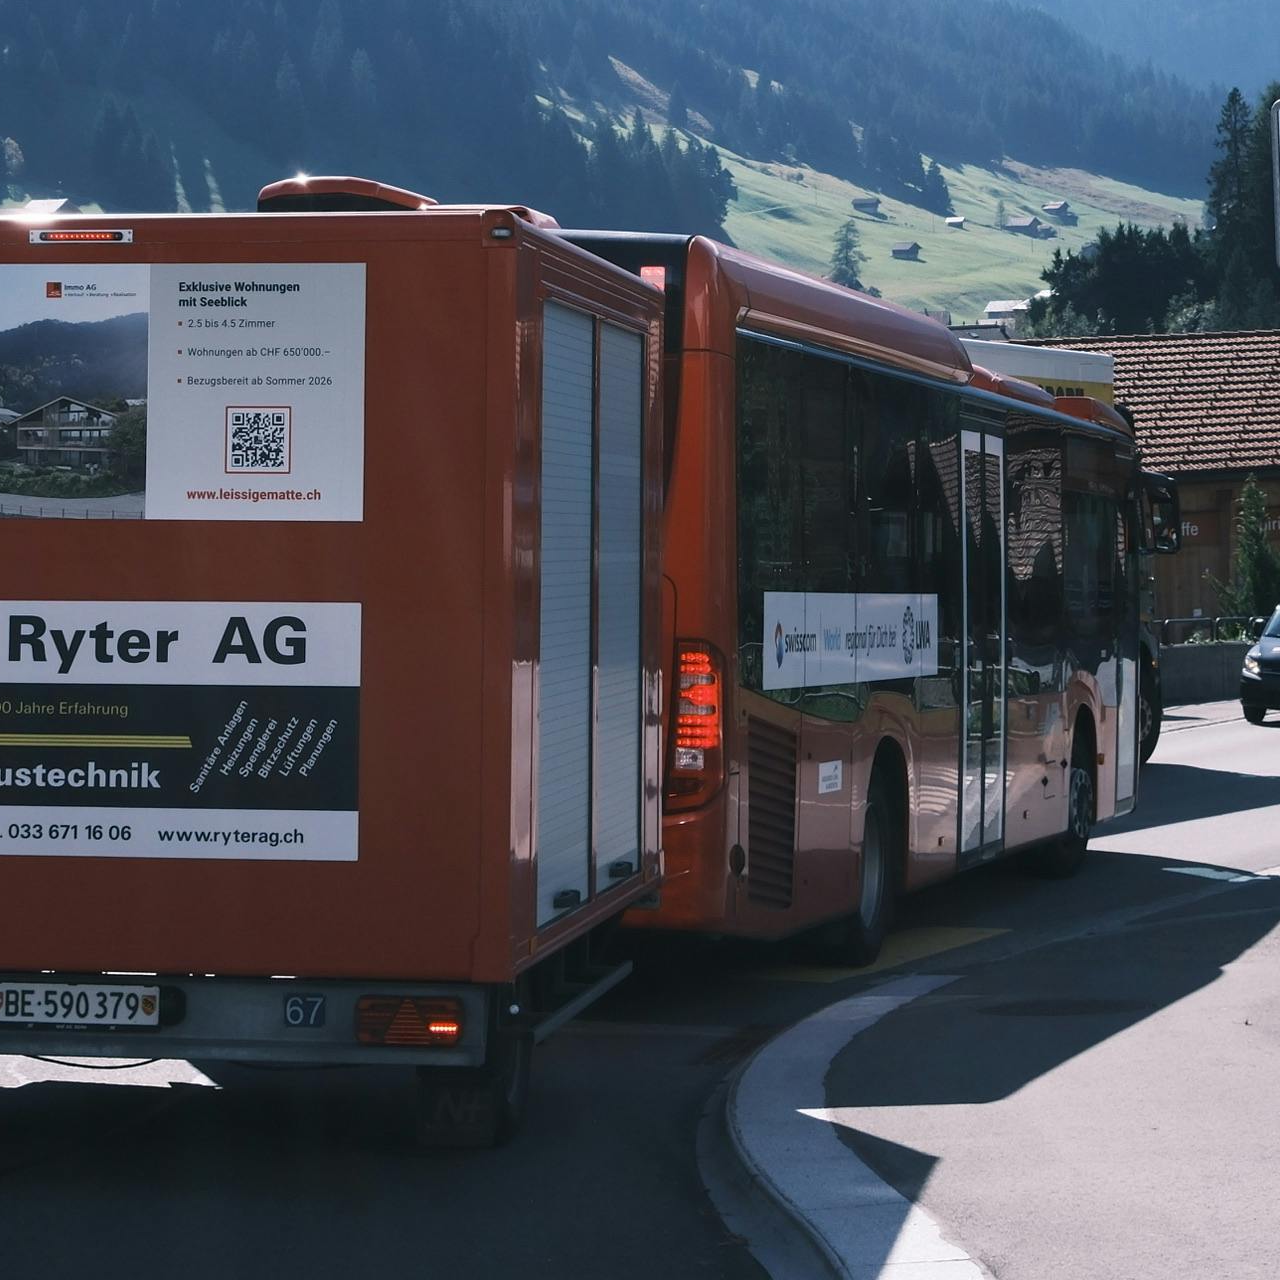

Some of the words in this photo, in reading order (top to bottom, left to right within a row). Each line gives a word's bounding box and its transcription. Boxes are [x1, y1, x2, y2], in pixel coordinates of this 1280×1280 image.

[178, 281, 232, 292] Exklusive
[234, 282, 299, 294] Wohnungen
[178, 296, 197, 307] mit
[199, 296, 248, 308] Seeblick
[187, 318, 203, 328] 2.5
[204, 318, 220, 329] bis
[221, 318, 237, 328] 4.5
[238, 318, 276, 328] Zimmer
[187, 347, 244, 359] Wohnungen
[245, 347, 258, 357] ab
[259, 347, 281, 357] CHF
[187, 375, 249, 388] Bezugsbereit
[251, 375, 264, 386] ab
[265, 376, 306, 386] Sommer
[308, 376, 333, 386] 2026
[187, 488, 320, 502] www.leissigematte.ch
[9, 615, 178, 674] Ryter
[212, 616, 306, 665] AG
[784, 626, 817, 654] swisscom
[16, 702, 54, 714] Jahre
[60, 702, 128, 717] Erfahrung
[189, 746, 221, 793] Sanitäre
[217, 700, 248, 746] Anlagen
[220, 717, 259, 776] Heizungen
[238, 717, 278, 778] Spenglerei
[257, 716, 299, 779] Blitzschutz
[278, 718, 318, 777] Lüftungen
[298, 718, 338, 777] Planungen
[9, 824, 42, 839] 033
[49, 825, 77, 839] 671
[85, 825, 102, 840] 16
[109, 826, 131, 840] 06
[158, 829, 303, 846] www.ryterag.ch
[286, 996, 323, 1025] 67
